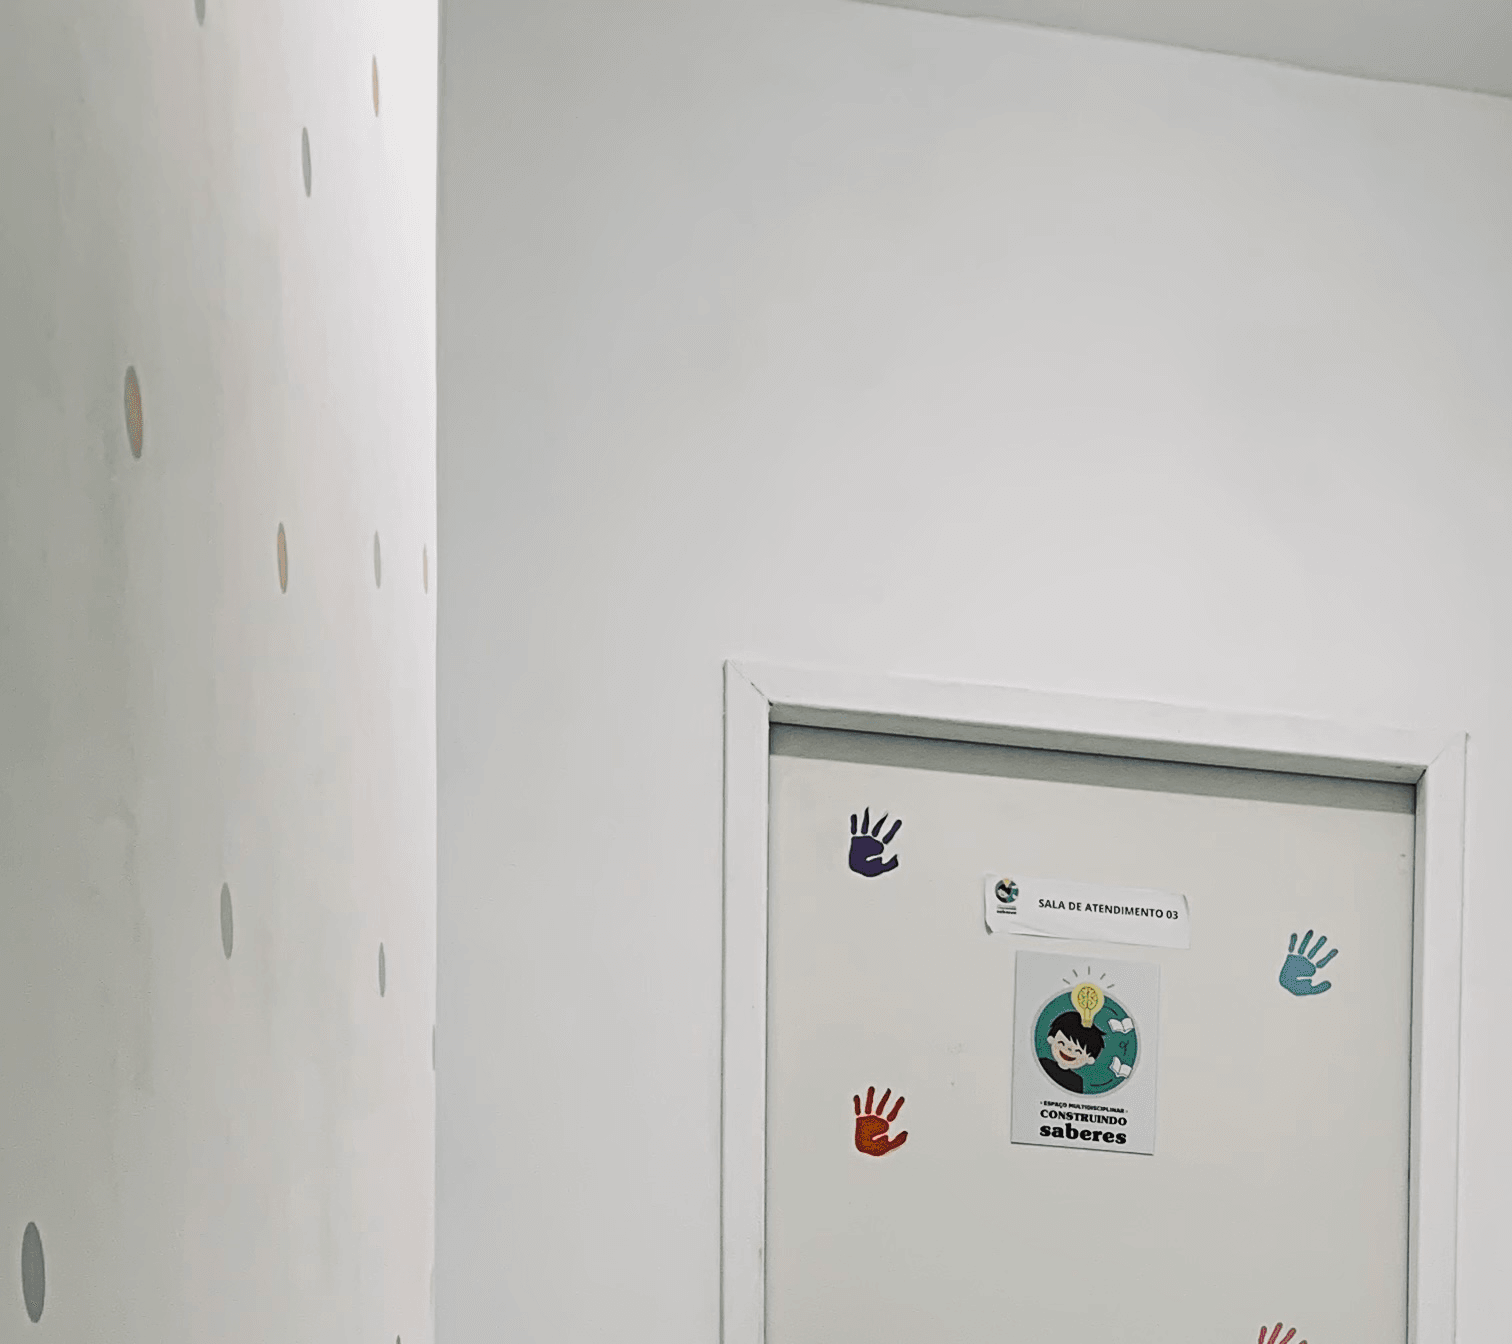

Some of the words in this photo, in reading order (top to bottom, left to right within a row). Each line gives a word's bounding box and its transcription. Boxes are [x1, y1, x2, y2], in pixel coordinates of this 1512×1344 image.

[1038, 898, 1066, 910] SALA
[1068, 901, 1082, 912] DE
[1085, 903, 1164, 919] ATENDIMENTO
[1166, 910, 1179, 920] 03
[1043, 1100, 1068, 1109] ESPAÇO
[1068, 1103, 1125, 1114] MULTIDISCIPLINAR
[1040, 1109, 1128, 1126] CONSTRUINDO
[1039, 1122, 1127, 1144] saberes
